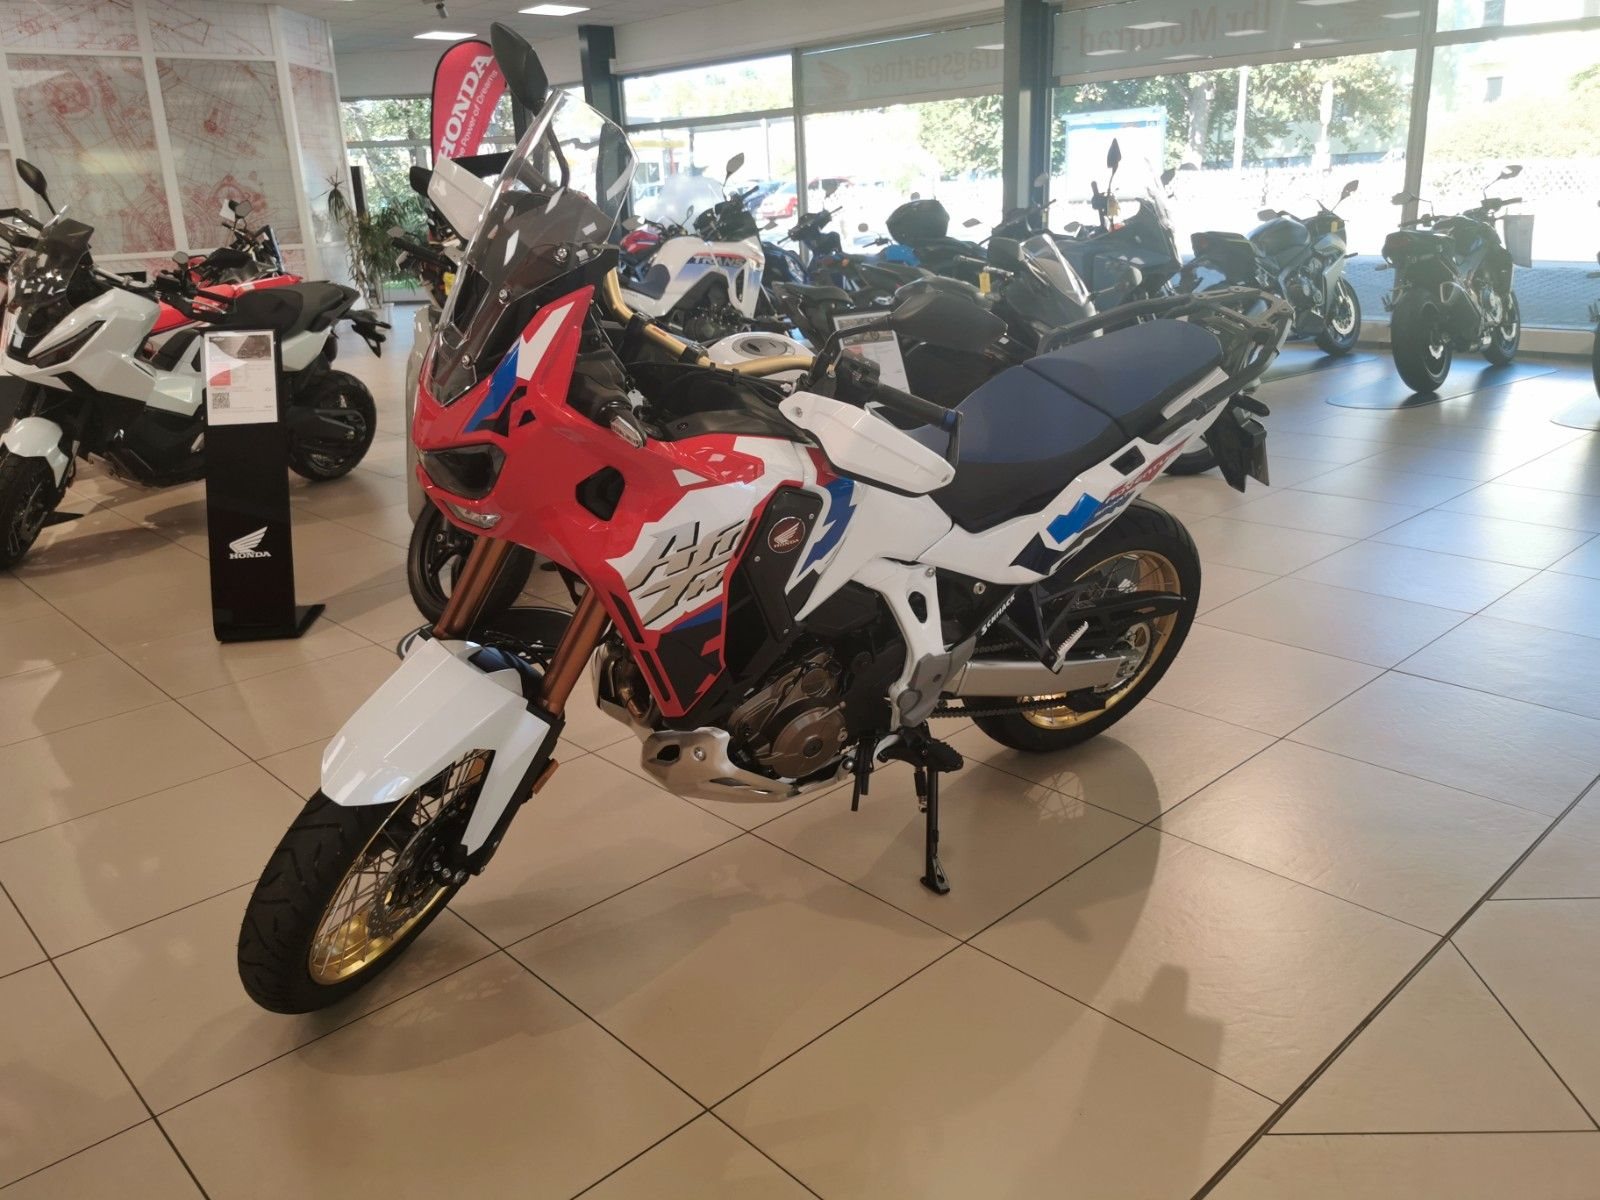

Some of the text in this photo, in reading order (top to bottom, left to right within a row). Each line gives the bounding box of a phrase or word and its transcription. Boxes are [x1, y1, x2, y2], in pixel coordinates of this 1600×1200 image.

[439, 55, 495, 160] HONDA
[461, 114, 477, 147] Power
[473, 100, 482, 116] of
[478, 70, 498, 105] Dreams
[229, 551, 272, 560] HONDA
